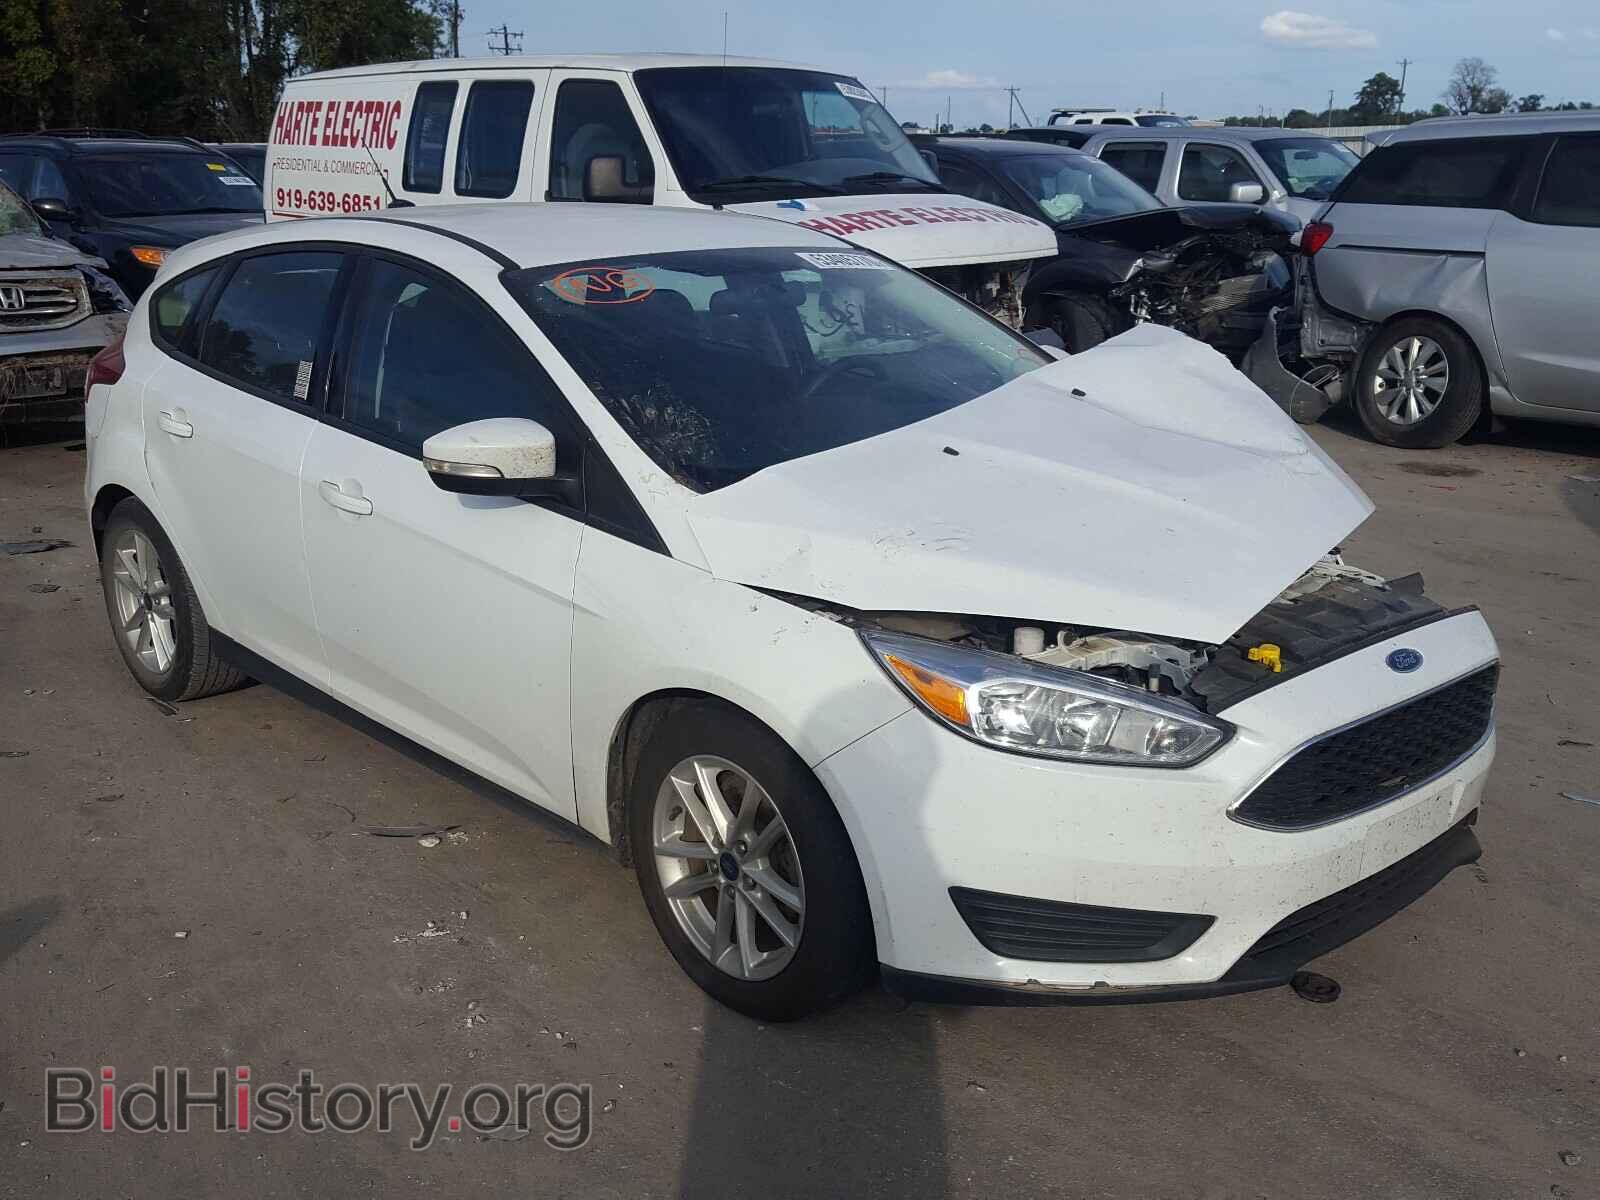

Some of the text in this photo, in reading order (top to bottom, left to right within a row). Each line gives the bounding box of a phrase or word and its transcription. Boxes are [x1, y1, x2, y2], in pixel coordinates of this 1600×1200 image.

[273, 100, 402, 151] HARTE ELECTRIC
[276, 157, 322, 173] RESIDENTIAL
[323, 160, 330, 173] &
[799, 208, 920, 236] HARTE
